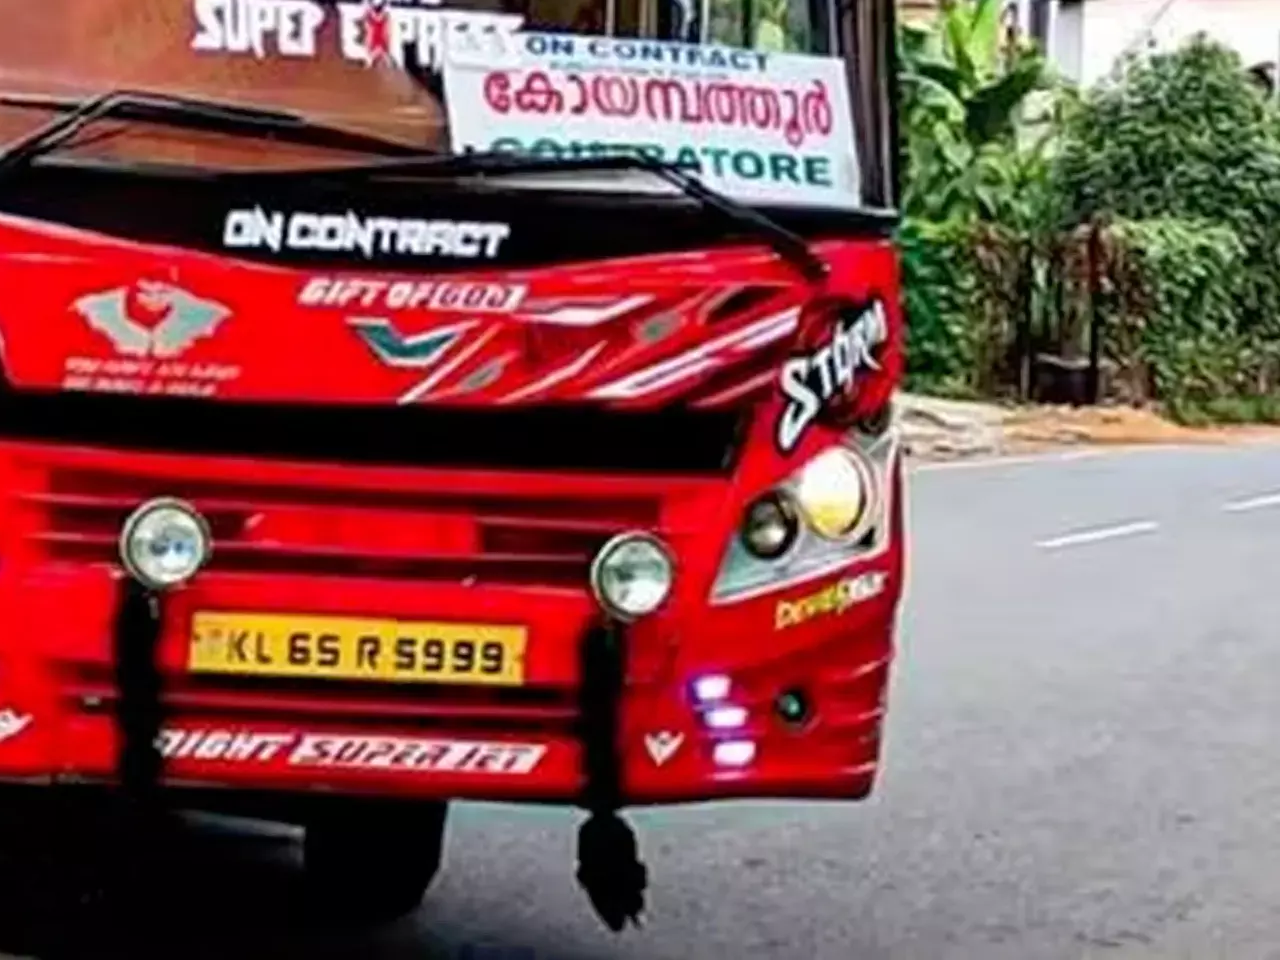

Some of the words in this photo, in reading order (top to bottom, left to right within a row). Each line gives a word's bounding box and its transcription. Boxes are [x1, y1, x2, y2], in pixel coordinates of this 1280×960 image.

[526, 36, 575, 57] ON
[588, 39, 770, 73] CONTRACT
[224, 208, 283, 252] ON
[287, 212, 509, 258] CONTRACT
[227, 632, 273, 666] KL
[287, 632, 342, 668] 65
[356, 635, 382, 671] R
[395, 638, 505, 675] 5999
